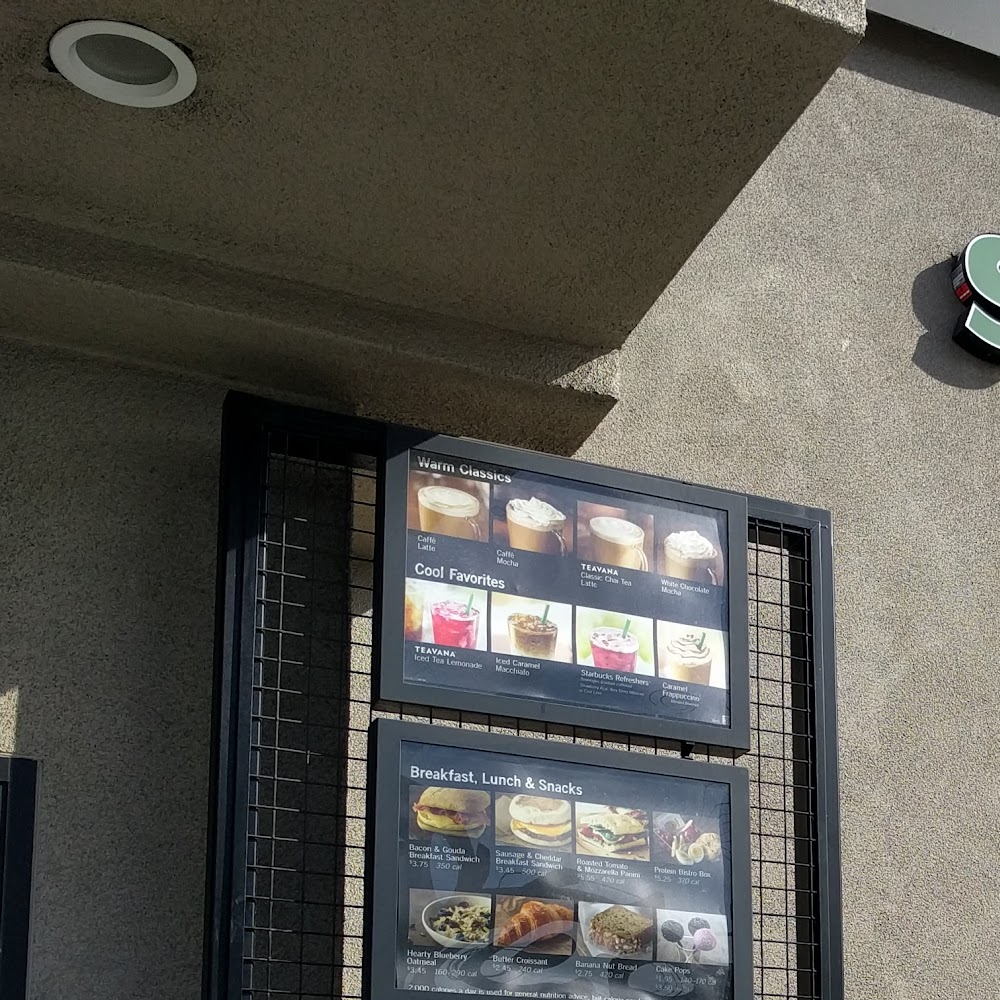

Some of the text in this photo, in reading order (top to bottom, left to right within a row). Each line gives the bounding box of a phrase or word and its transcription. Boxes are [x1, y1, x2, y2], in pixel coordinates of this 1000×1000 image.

[417, 456, 512, 483] Warm Classics
[417, 535, 437, 544] Caffè
[417, 542, 436, 552] Latte
[496, 550, 514, 558] Caffè
[496, 557, 519, 567] Mocha
[414, 562, 505, 589] Cool Favorites
[580, 563, 618, 576] TEAVANA
[580, 571, 632, 587] Classic Chai Tea
[580, 580, 597, 588] Latte
[661, 578, 710, 595] White Chocolate
[661, 586, 682, 596] Mocha
[414, 645, 455, 658] TEAVANA
[414, 654, 483, 670] Iced Tea Lemonade
[495, 657, 541, 670] Iced Caramel
[495, 666, 530, 676] Macchiato
[581, 669, 649, 686] Starbucks Refreshers
[662, 682, 688, 692] Caramel
[662, 690, 700, 702] Frappuccino
[410, 765, 583, 796] Breakfast, Lunch & Snacks
[409, 844, 432, 852] Bacon
[442, 846, 466, 855] Gouda
[409, 852, 480, 863] Breakfast Sandwich
[495, 850, 525, 859] Sausage
[534, 852, 562, 863] Cheddar
[452, 863, 462, 871] cal
[495, 857, 563, 870] Breakfast Sandwich
[576, 858, 628, 870] Roasted Tomato
[537, 869, 547, 877] cal
[584, 866, 619, 876] Mozzarella
[620, 870, 641, 879] Panini
[654, 866, 711, 878] Protein Bistro Box
[406, 957, 437, 966] Oatmeal
[407, 949, 468, 962] Hearty Blueberry
[492, 955, 548, 966] Butter Croissant
[575, 960, 638, 972] Banana Nut Bread
[655, 965, 691, 975] Cake Pops
